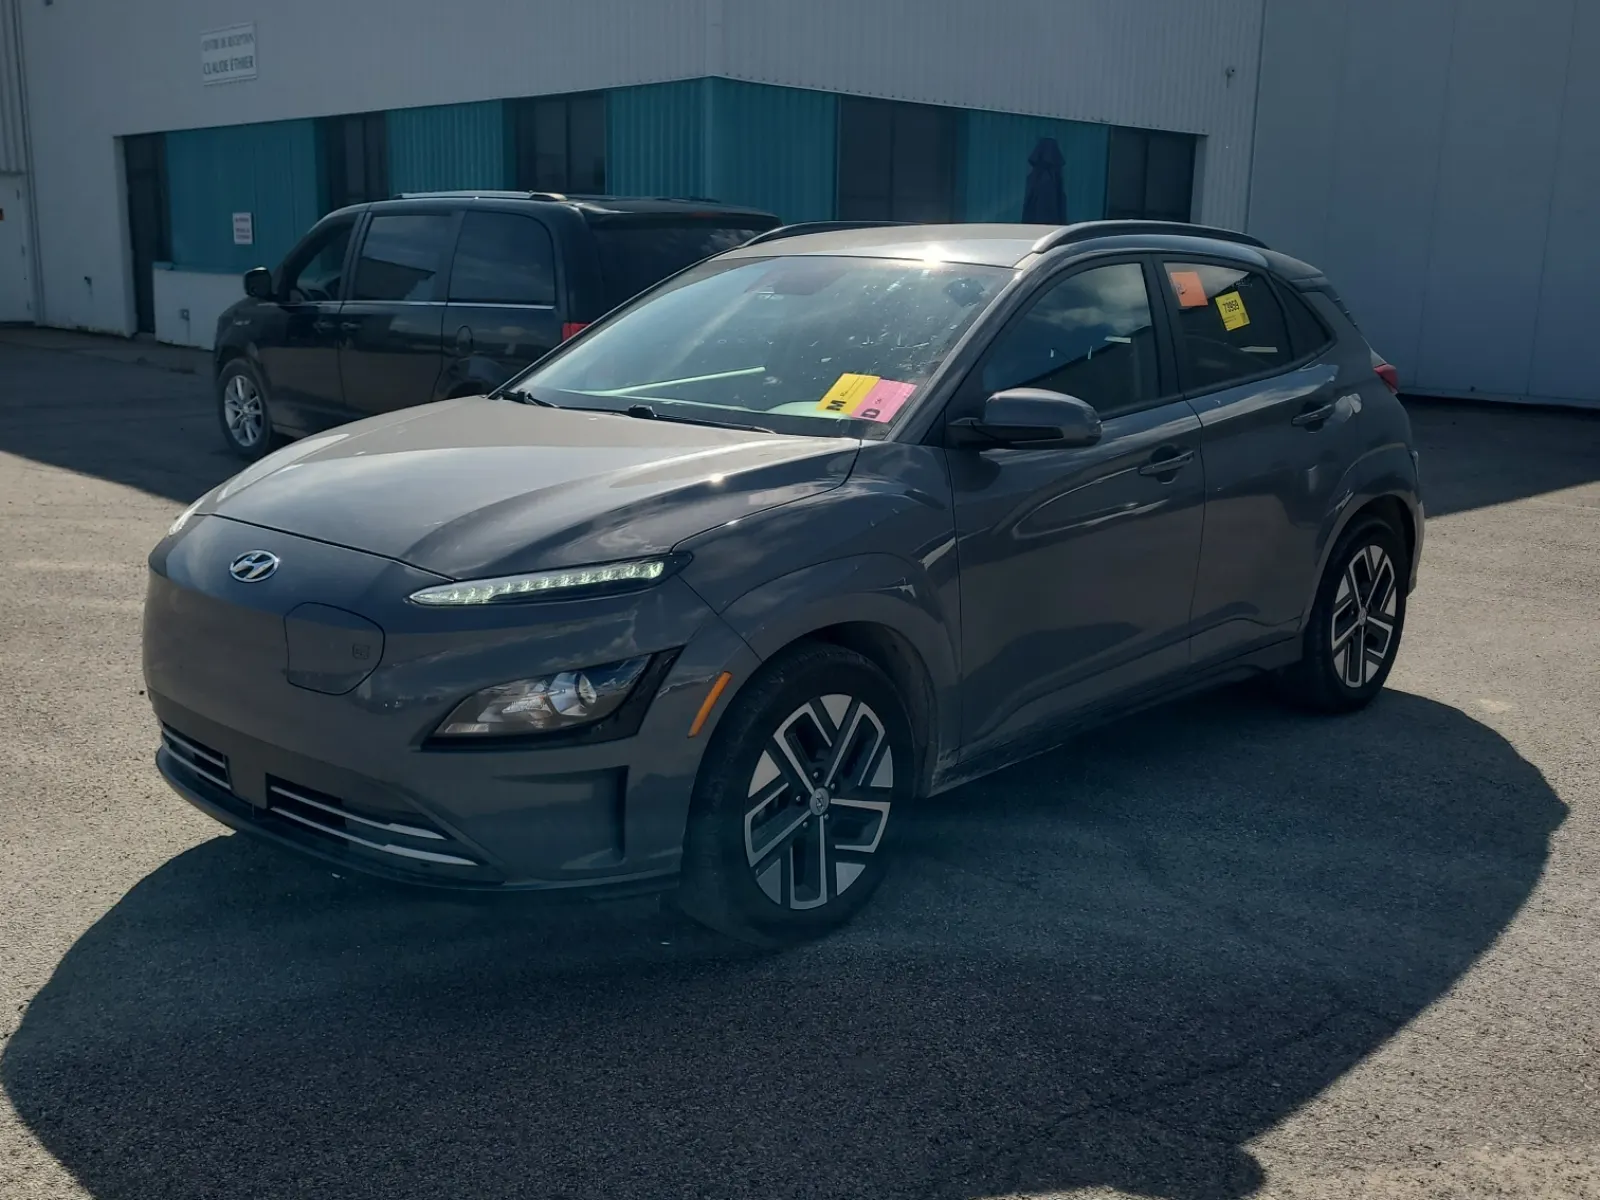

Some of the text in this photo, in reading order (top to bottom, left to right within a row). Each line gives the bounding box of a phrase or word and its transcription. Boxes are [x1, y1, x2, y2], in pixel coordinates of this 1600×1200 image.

[203, 59, 229, 75] CLAUDE
[825, 399, 847, 411] M
[861, 408, 881, 419] D
